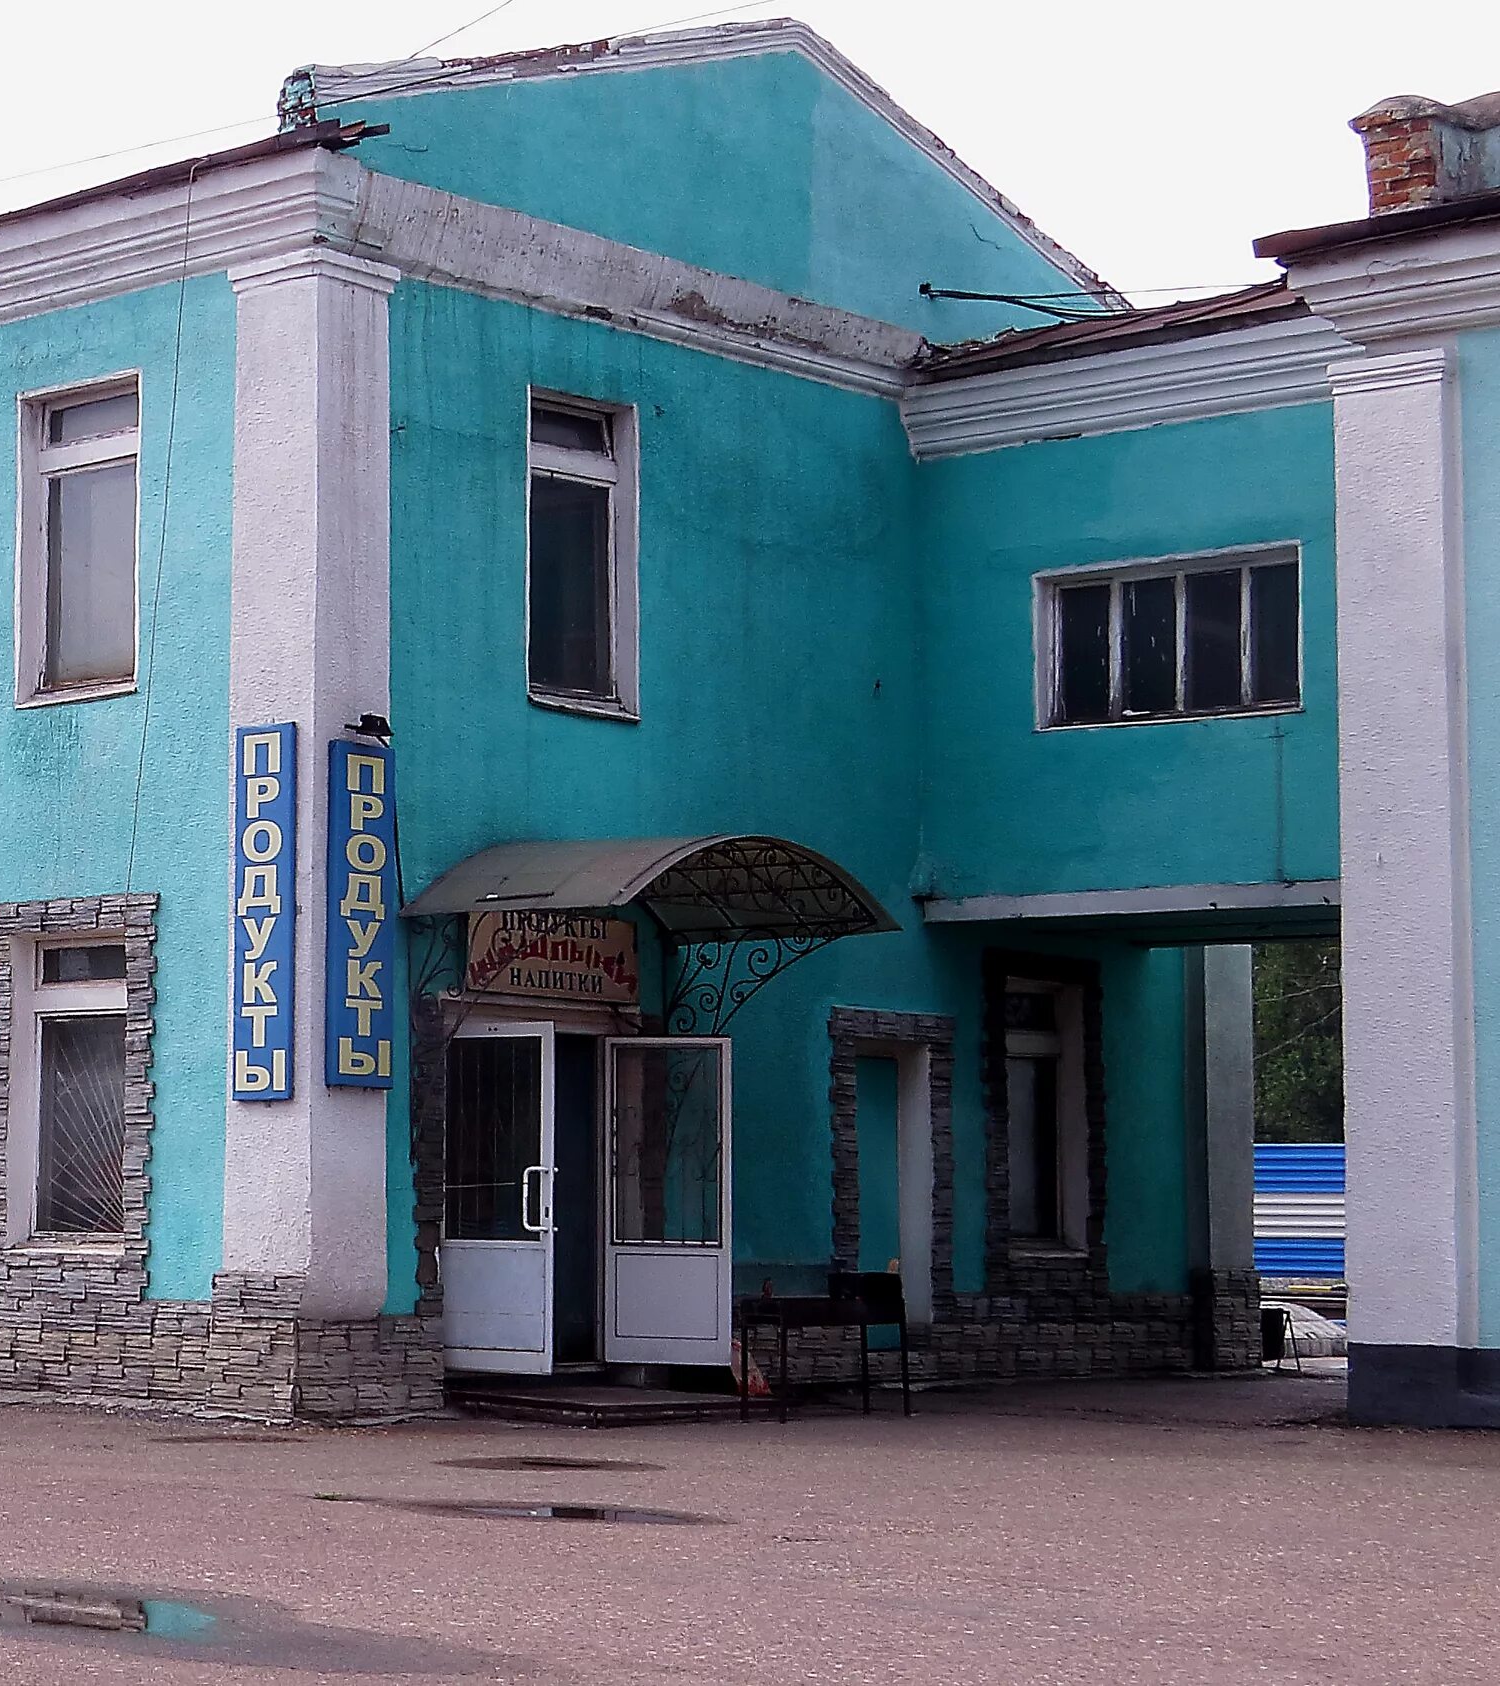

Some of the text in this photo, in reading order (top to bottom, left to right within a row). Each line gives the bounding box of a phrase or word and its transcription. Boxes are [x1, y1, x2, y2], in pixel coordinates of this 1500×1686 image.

[234, 731, 286, 1092] ПРОДУКТЫ
[338, 753, 391, 1077] ПРОДУКТЫ
[503, 911, 608, 940] ПРОДУКТЫ
[509, 967, 603, 994] НАПИТКИ
